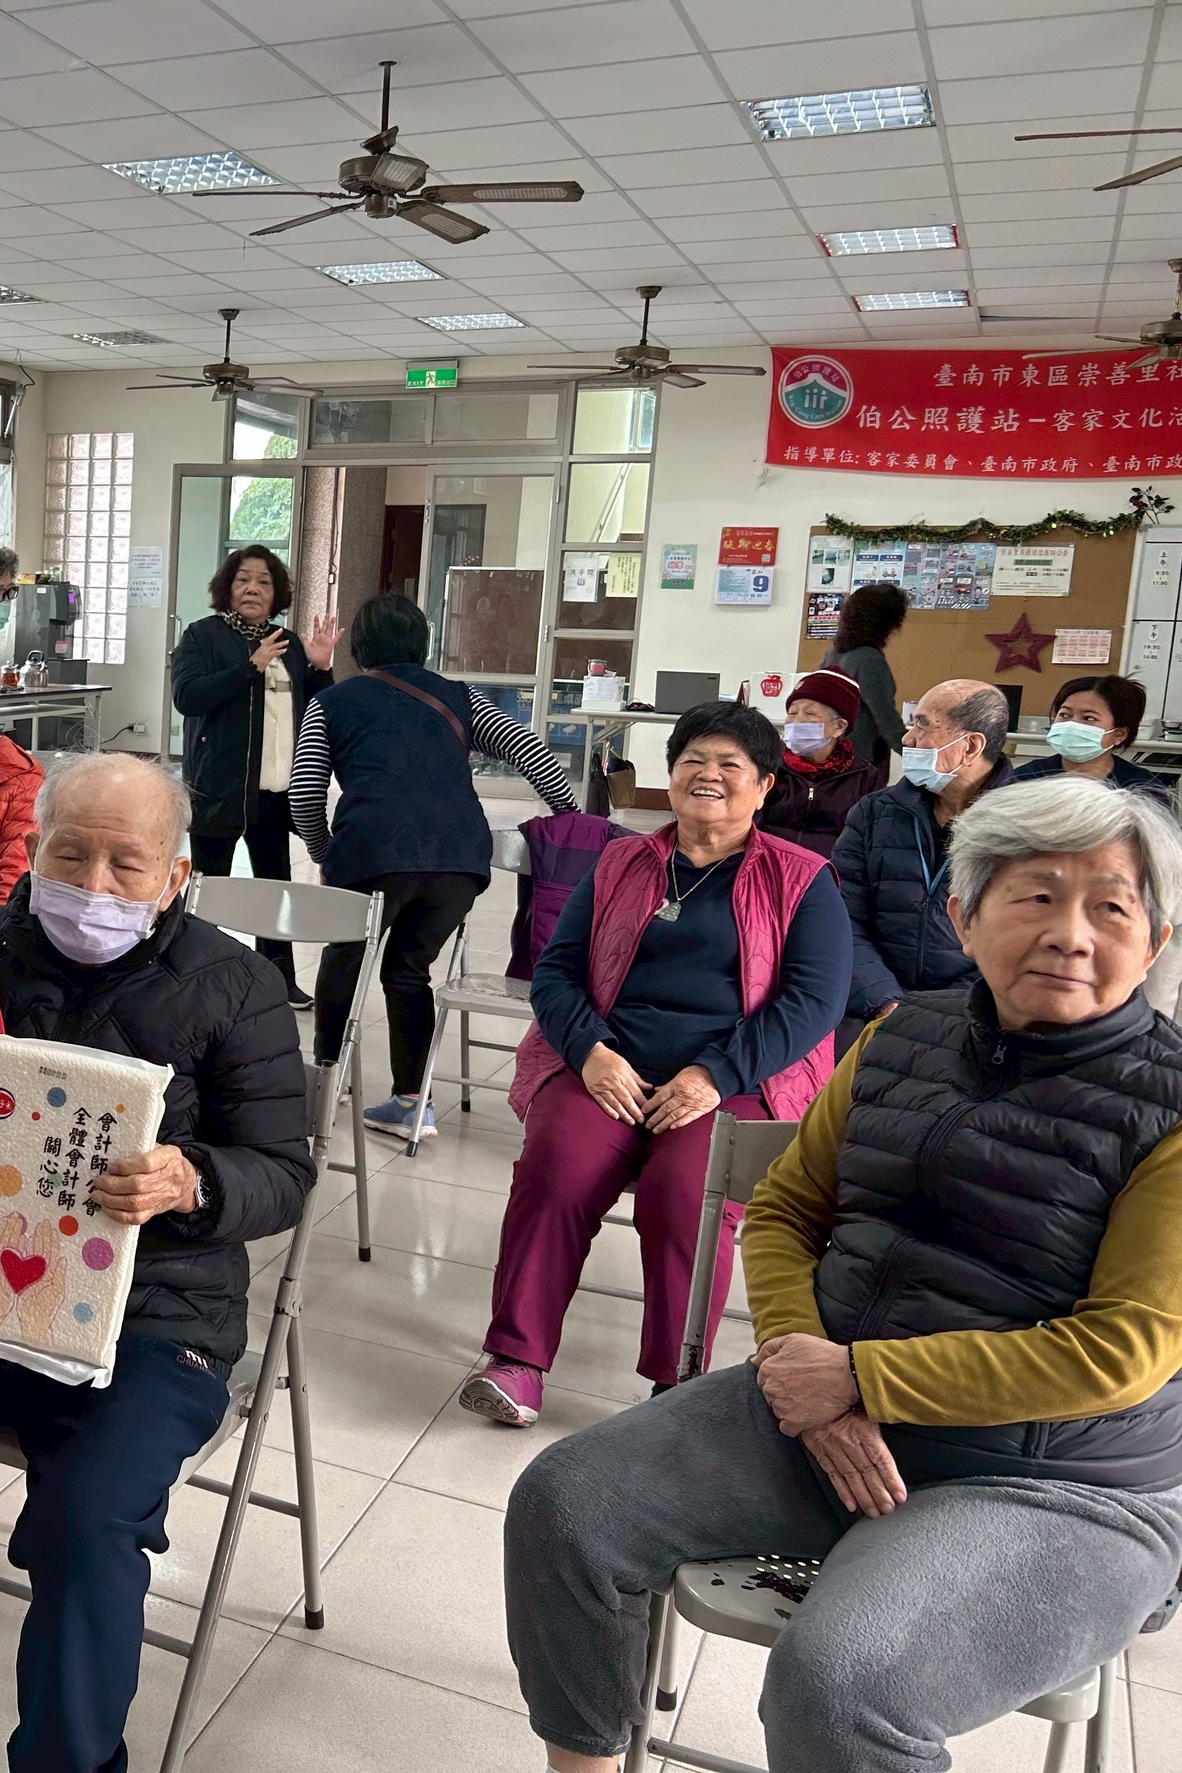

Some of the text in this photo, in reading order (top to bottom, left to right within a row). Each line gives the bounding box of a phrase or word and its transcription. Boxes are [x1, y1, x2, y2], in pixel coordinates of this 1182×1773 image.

[752, 575, 769, 593] 9
[36, 1136, 62, 1198] 關心您
[57, 1106, 93, 1211] 全體會計師
